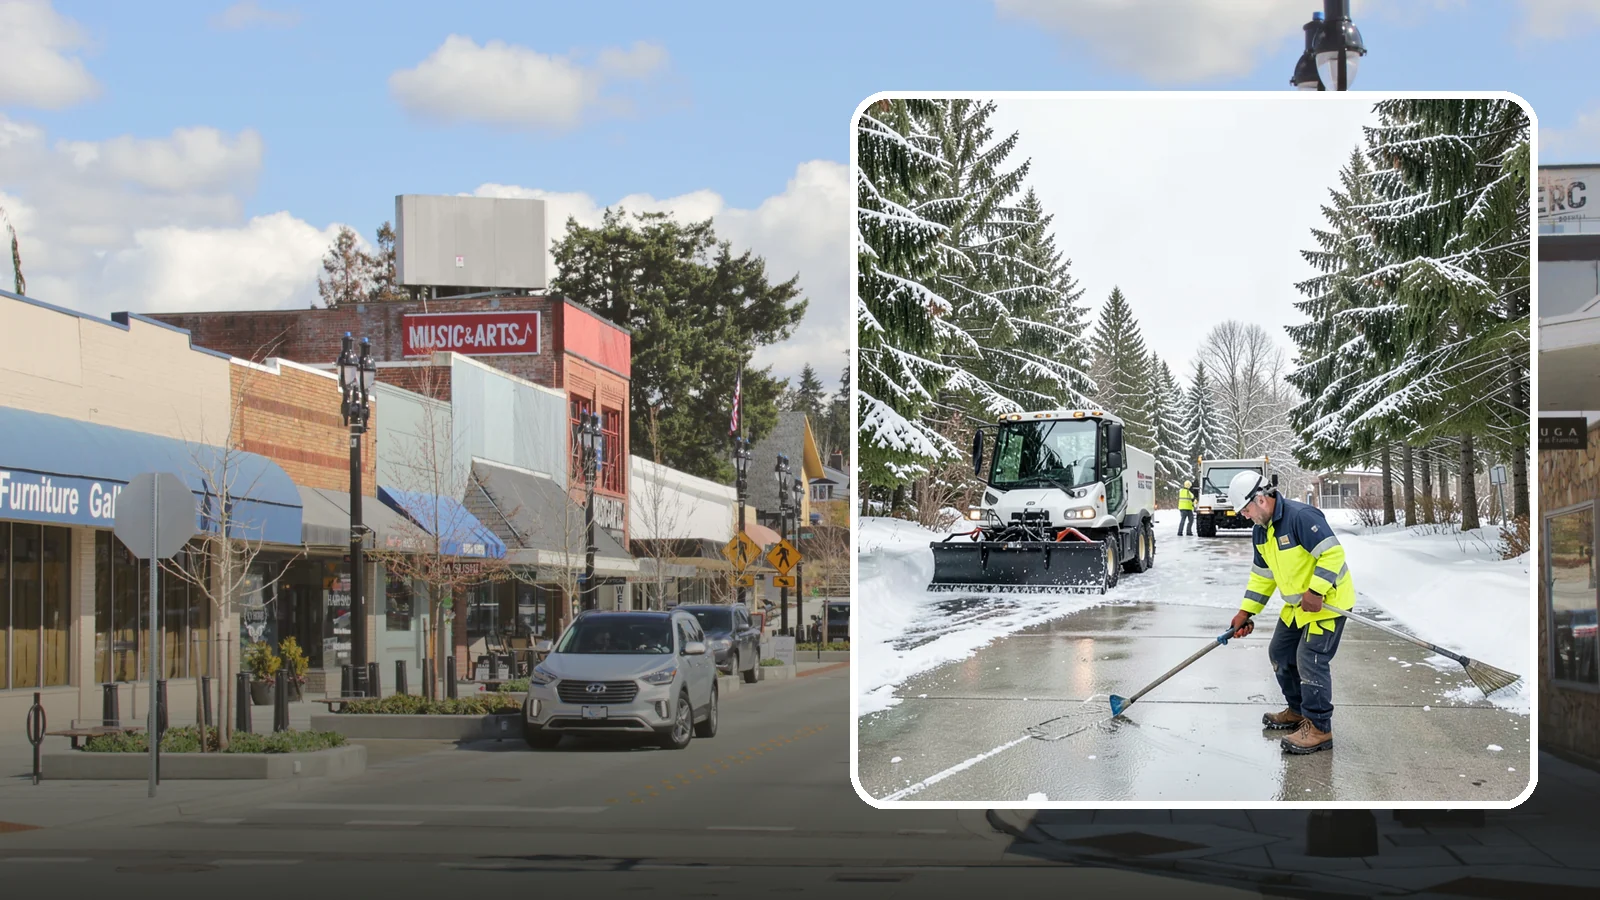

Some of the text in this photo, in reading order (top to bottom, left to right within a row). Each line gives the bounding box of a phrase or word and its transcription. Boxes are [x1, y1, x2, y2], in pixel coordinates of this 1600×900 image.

[409, 323, 519, 349] MUSIC&ARTS
[1540, 427, 1577, 436] UGA
[0, 471, 79, 516] Furniture
